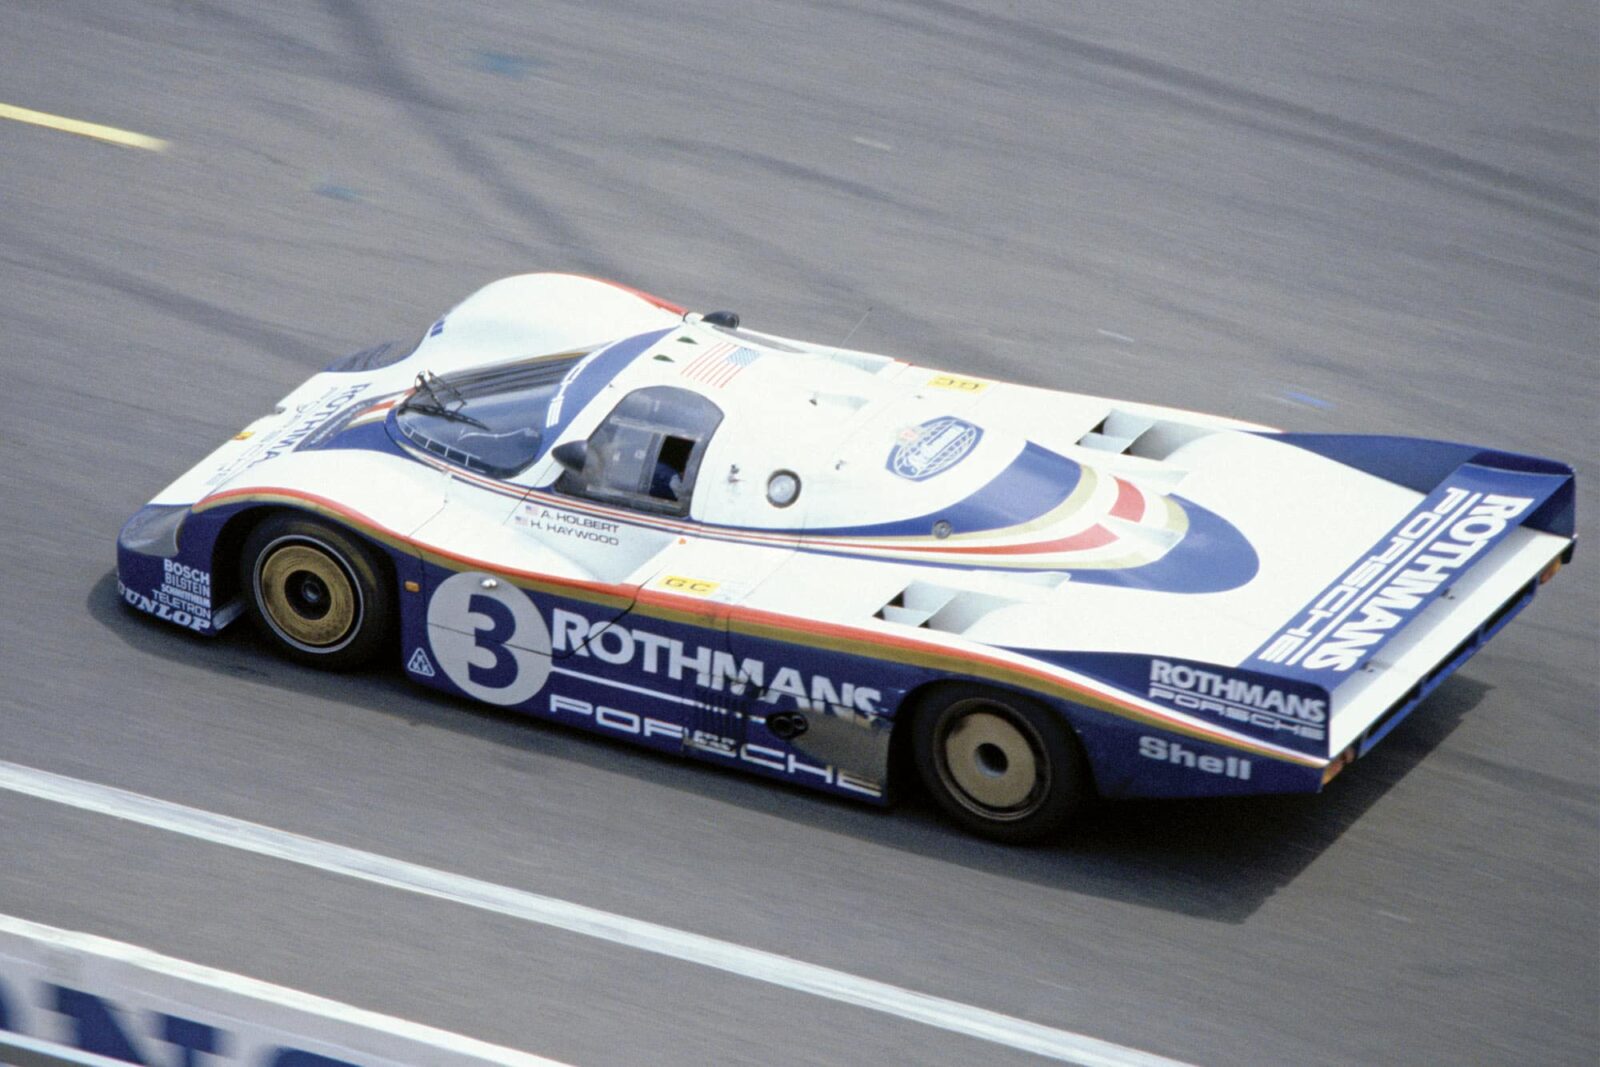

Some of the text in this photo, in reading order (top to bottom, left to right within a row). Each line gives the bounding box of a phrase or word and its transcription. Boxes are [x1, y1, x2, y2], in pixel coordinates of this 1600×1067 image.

[546, 522, 619, 546] HAYWOOD
[556, 511, 620, 533] HOLBERT
[164, 558, 210, 586] BOSCH
[165, 572, 211, 598] BILSTEIN
[664, 577, 711, 592] GC
[1257, 487, 1470, 663] PORSCHE
[1302, 493, 1535, 672] ROTHMANS
[117, 578, 211, 631] DUNLOP
[152, 589, 211, 620] TELETRON
[467, 593, 519, 689] 3
[552, 608, 881, 729] ROTHMANS
[1151, 659, 1326, 723] ROTHMANS
[1149, 687, 1325, 741] PORSCHE
[1139, 735, 1251, 780] Shell
